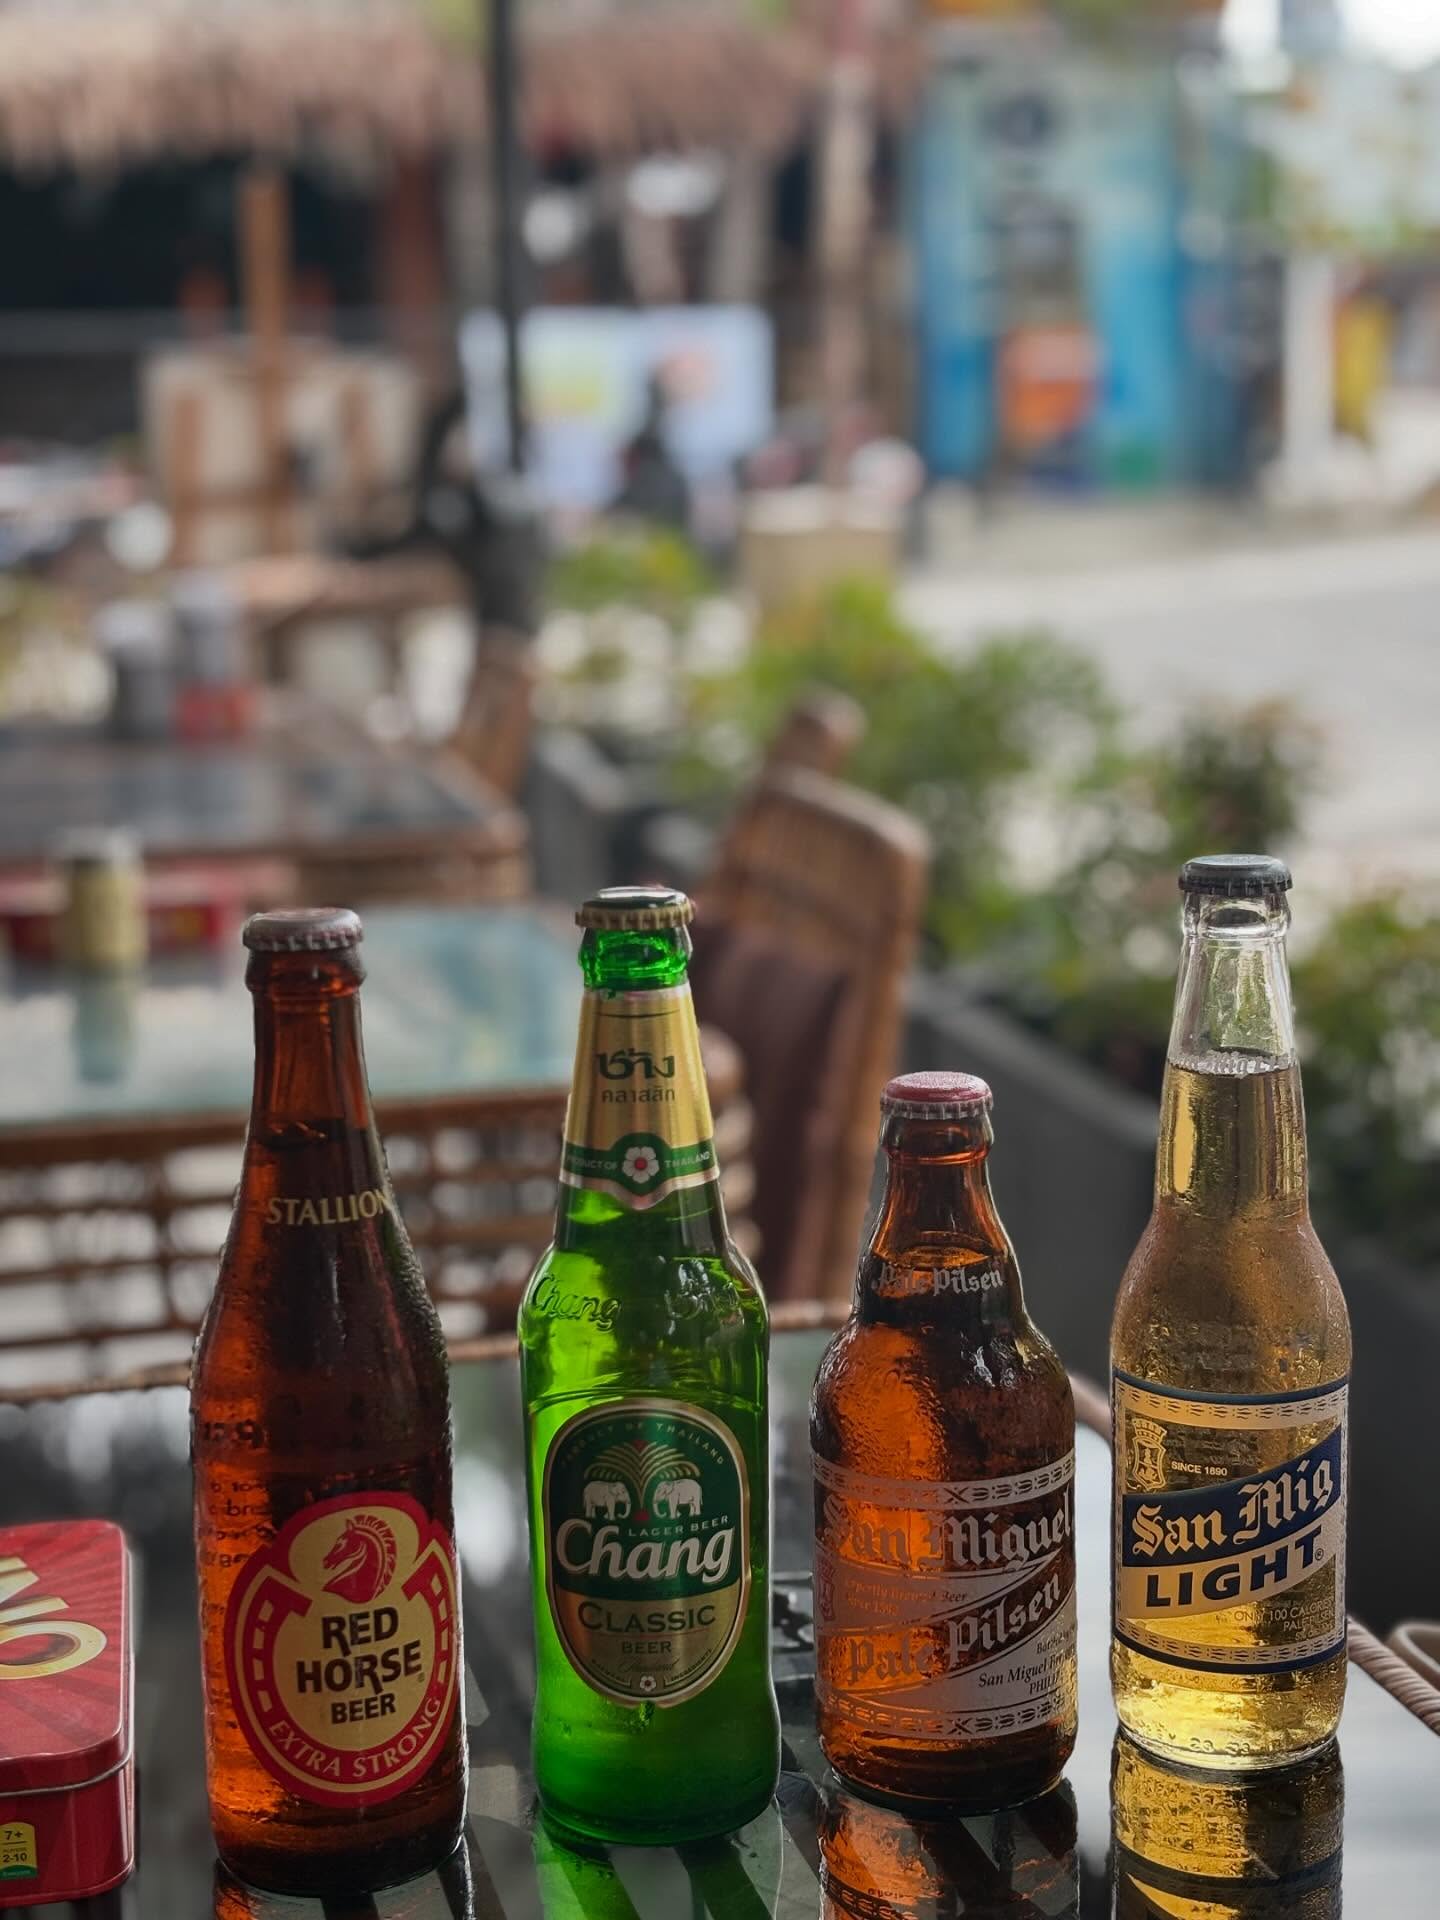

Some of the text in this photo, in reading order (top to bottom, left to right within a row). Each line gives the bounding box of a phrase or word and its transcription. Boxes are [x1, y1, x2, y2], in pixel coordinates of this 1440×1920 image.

[266, 1188, 391, 1225] STALLION
[933, 1265, 1004, 1296] Pilsen
[1170, 1460, 1228, 1476] SINCE 1890
[1132, 1458, 1334, 1559] San Mig
[628, 1515, 729, 1537] LAGER BEER
[918, 1484, 1072, 1572] Miguel
[556, 1518, 736, 1583] Chang
[1145, 1524, 1323, 1609] LIGHT
[578, 1601, 716, 1633] CLASSIC
[847, 1573, 1061, 1685] Pale Pilsen
[1269, 1607, 1288, 1621] 100
[322, 1606, 399, 1657] RED
[622, 1640, 672, 1654] BEER
[295, 1640, 423, 1695] HORSE
[978, 1671, 1004, 1688] San
[1008, 1657, 1047, 1684] Miguel
[331, 1693, 396, 1724] BEER
[269, 1697, 441, 1778] EXTRA STRONG
[4, 1830, 24, 1841] 7+
